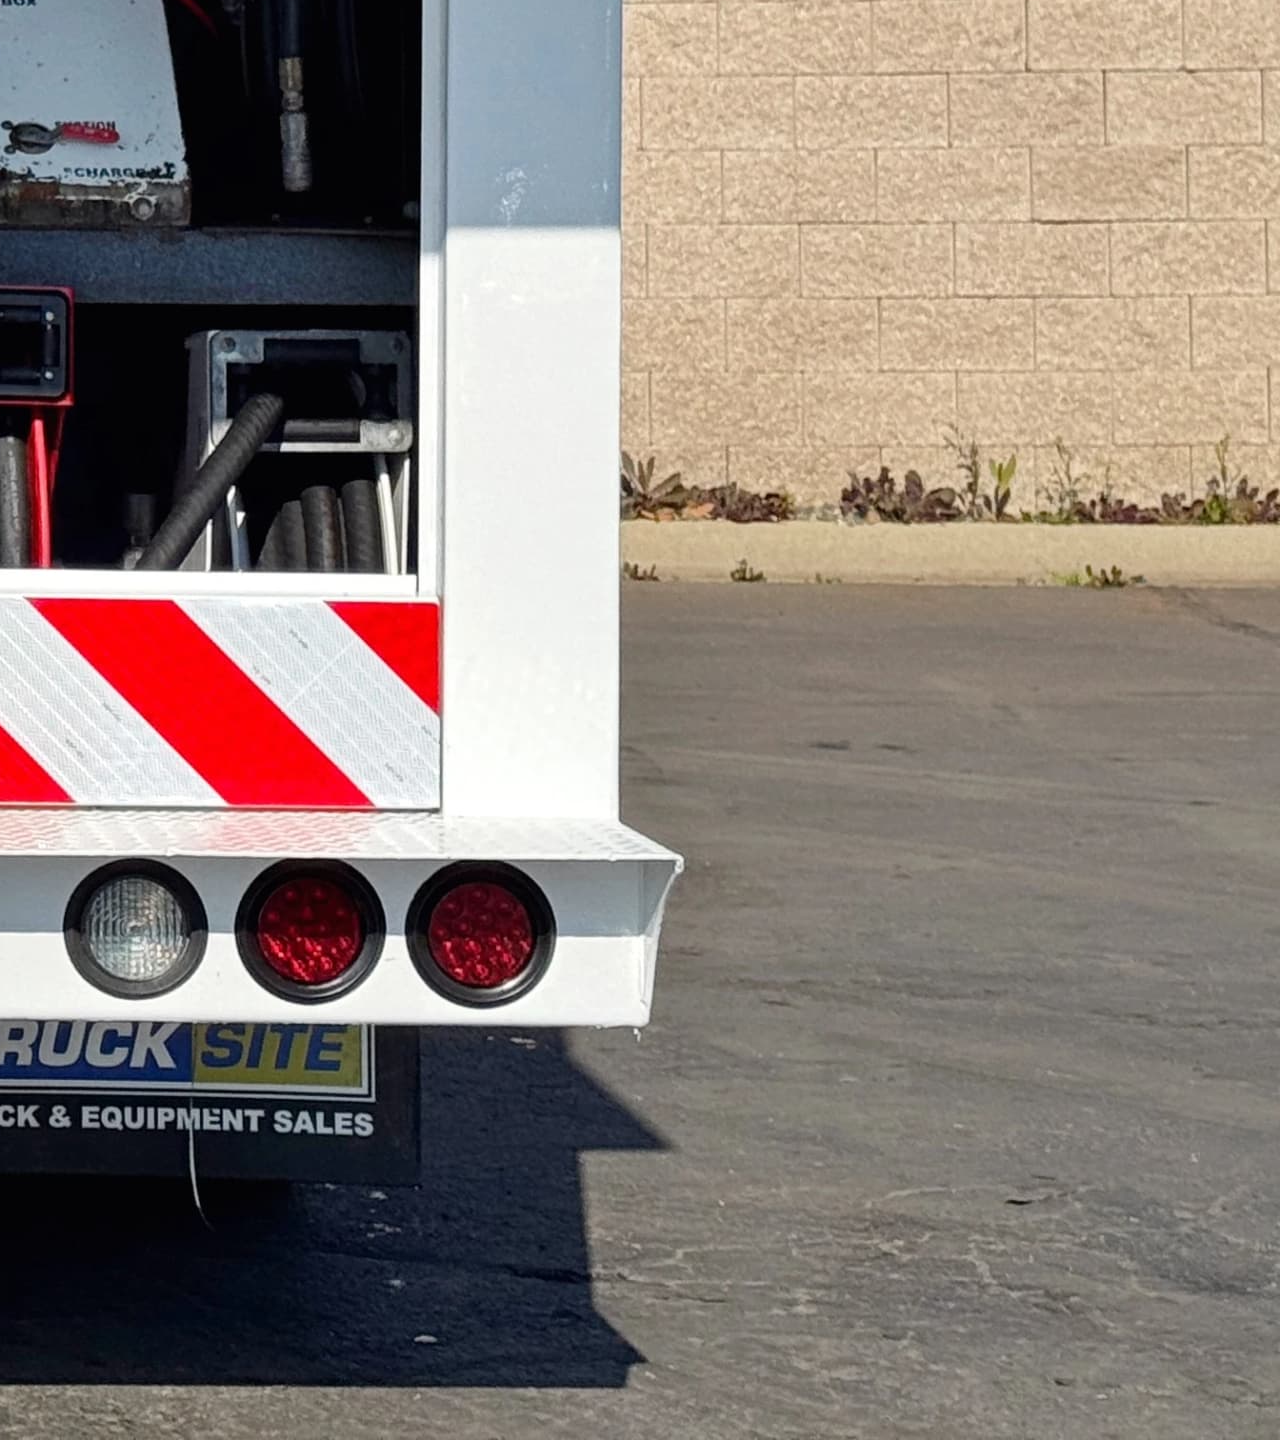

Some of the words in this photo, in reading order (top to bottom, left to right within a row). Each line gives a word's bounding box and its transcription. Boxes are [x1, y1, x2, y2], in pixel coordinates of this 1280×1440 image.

[200, 1023, 348, 1072] SITE
[49, 1105, 72, 1128] &
[81, 1106, 264, 1133] EQUIPMENT
[273, 1108, 374, 1137] SALES
